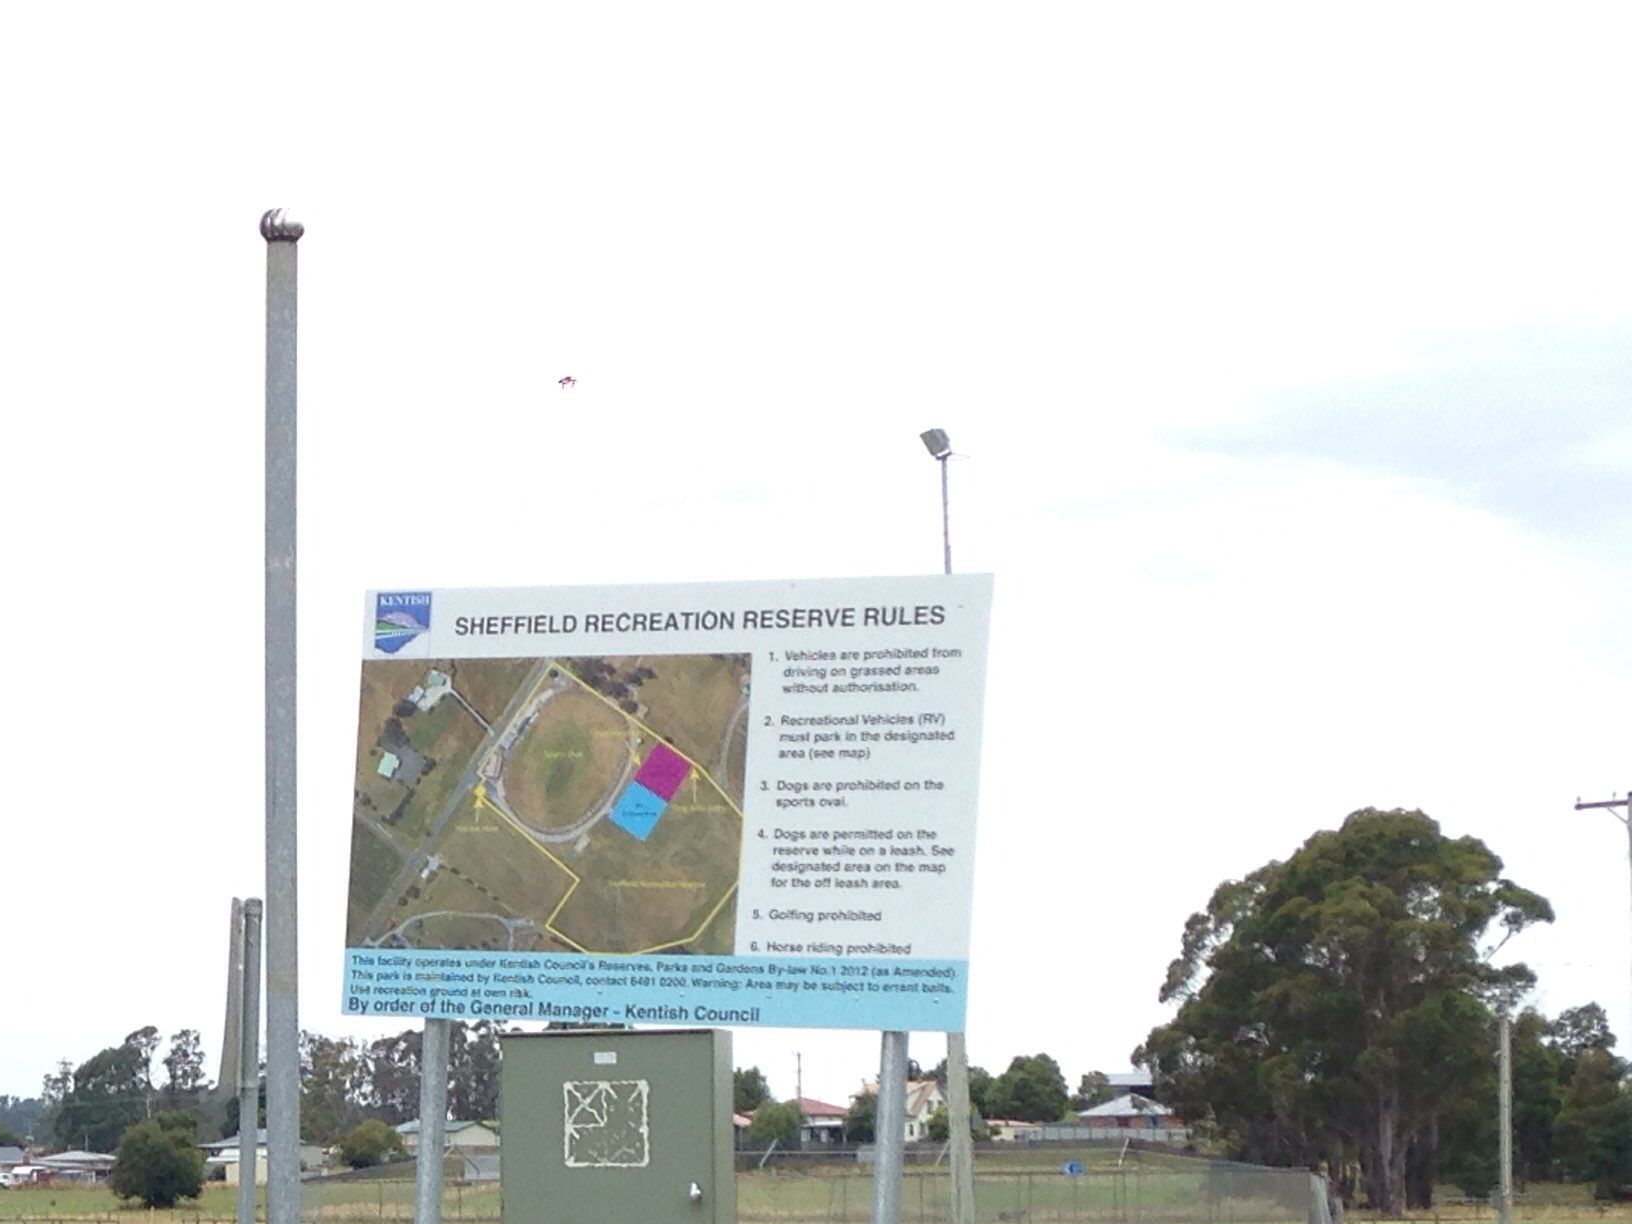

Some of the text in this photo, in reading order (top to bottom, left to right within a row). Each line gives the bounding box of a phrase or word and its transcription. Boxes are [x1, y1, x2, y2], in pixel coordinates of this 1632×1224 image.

[455, 604, 946, 636] SHEFFIELD RECREATION RESERVE RULES
[785, 650, 836, 661] Vehicles
[840, 652, 859, 660] are
[863, 648, 928, 662] prohibited
[933, 647, 962, 658] from
[784, 665, 939, 679] driving on grassed areas
[783, 684, 828, 693] without
[781, 714, 858, 726] Recreational
[862, 714, 914, 725] Vehicles
[918, 713, 946, 726] (RV)
[780, 729, 955, 744] must park in the designated
[779, 748, 871, 760] area (see map)
[777, 780, 809, 794] Dogs
[812, 782, 832, 791] are
[836, 780, 901, 794] prohibited
[903, 782, 920, 790] on
[924, 780, 944, 790] the
[776, 797, 816, 809] sports
[774, 828, 806, 842] Dogs
[810, 830, 829, 839] are
[833, 829, 893, 842] permitted
[897, 830, 913, 839] on
[917, 829, 937, 839] the
[773, 846, 818, 856] reserve
[823, 845, 856, 856] while
[859, 847, 875, 856] on
[879, 847, 886, 856] a
[931, 845, 954, 856] See
[772, 861, 946, 875] designated area on the map
[771, 878, 788, 888] for
[792, 878, 811, 888] the
[815, 878, 831, 888] off
[835, 878, 868, 888] leash
[769, 909, 814, 923] Golfing
[818, 910, 882, 922] prohibited
[767, 942, 803, 952] Horse
[807, 942, 843, 955] riding
[847, 942, 912, 955] prohibited
[352, 956, 374, 965] This
[378, 956, 411, 967] facility
[415, 958, 461, 969] operates
[465, 959, 496, 968] under
[500, 959, 540, 969] Kentish
[657, 962, 688, 972] Parks
[691, 963, 713, 973] and
[717, 963, 765, 974] Gardens
[871, 967, 889, 979] (as
[352, 970, 373, 980] This
[377, 971, 399, 981] park
[403, 972, 412, 980] is
[415, 972, 474, 982] maintained
[477, 973, 490, 984] by
[493, 973, 535, 983] Kentish
[586, 977, 627, 986] contact
[746, 979, 772, 989] Area
[776, 981, 798, 992] may
[803, 981, 817, 990] be
[822, 982, 863, 993] subject
[868, 982, 880, 992] to
[883, 983, 918, 992] errant
[350, 985, 370, 994] Use
[373, 986, 426, 996] recreation
[430, 988, 467, 998] ground
[471, 989, 481, 998] at
[484, 989, 506, 998] own
[348, 997, 369, 1014] By
[373, 999, 415, 1013] order
[420, 999, 437, 1013] of
[441, 1000, 465, 1014] the
[470, 1000, 533, 1016] General
[539, 1002, 609, 1020] Manager
[625, 1004, 689, 1020] Kentish
[694, 1005, 760, 1022] Council
